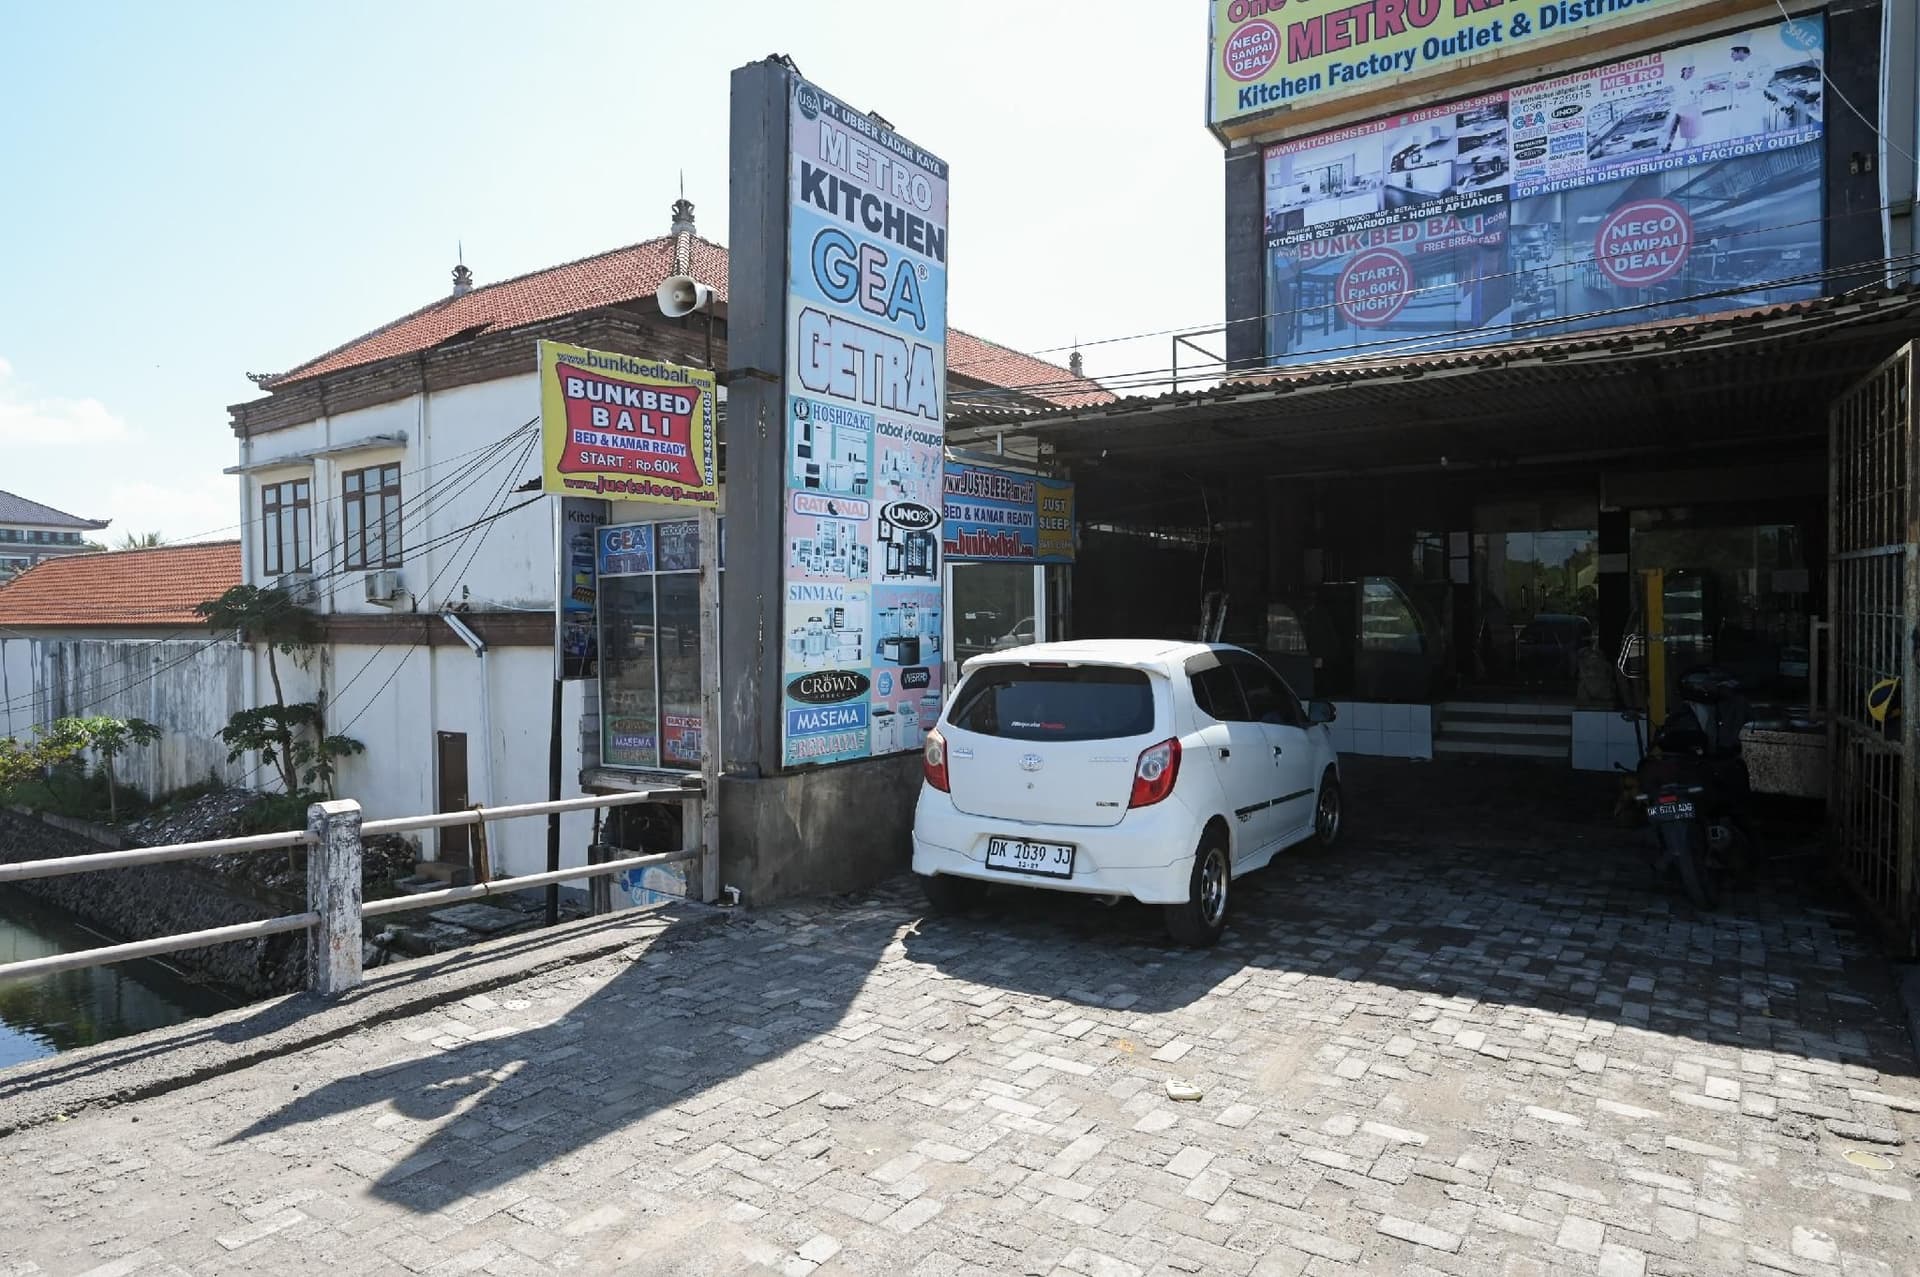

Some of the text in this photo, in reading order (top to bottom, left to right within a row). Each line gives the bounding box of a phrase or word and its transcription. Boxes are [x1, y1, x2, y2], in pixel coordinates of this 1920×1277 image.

[1233, 31, 1271, 50] NEGO
[1288, 0, 1441, 64] METRO
[1231, 43, 1273, 62] SAMPAI
[1235, 55, 1270, 73] DEAL
[1239, 73, 1321, 110] Kitchen
[1328, 48, 1416, 86] Factory
[1422, 20, 1503, 60] Outlet
[1510, 12, 1532, 38] &
[1511, 53, 1662, 97] www.metrokitchen.id
[1603, 67, 1662, 90] METRO
[799, 91, 819, 113] USA
[1513, 111, 1545, 130] GEA
[823, 97, 941, 175] PT. UBBER SADAR KAYA
[1267, 121, 1387, 158] WWW.KITCHENSET.ID
[819, 120, 933, 212] METRO
[1516, 185, 1540, 197] TOP
[1542, 176, 1595, 193] KITCHEN
[1597, 157, 1683, 181] DISTRIBUTOR
[1688, 153, 1698, 164] &
[1701, 141, 1763, 161] FACTORY
[1767, 129, 1822, 149] OUTLET
[801, 160, 945, 263] KITCHEN
[1268, 232, 1313, 248] KITCHEN
[1316, 227, 1336, 239] SET
[1346, 214, 1401, 232] WARDOBE
[1410, 205, 1442, 220] HOME
[1445, 193, 1504, 213] APLIANCE
[1612, 216, 1676, 240] NEGO
[1298, 230, 1366, 261] BUNK
[1368, 220, 1419, 250] BED
[1423, 241, 1446, 252] FREE
[1609, 232, 1678, 255] SAMPAI
[1614, 251, 1673, 272] DEAL
[812, 228, 926, 331] GEA
[1349, 266, 1400, 285] START:
[1352, 295, 1397, 313] NIGHT
[557, 352, 711, 388] www.bunkbedbali.com
[798, 306, 939, 421] GETRA
[566, 376, 692, 416] BUNKBED
[591, 405, 671, 438] BALI
[813, 404, 871, 431] HOSHIZAKI
[876, 422, 903, 438] robot
[575, 431, 686, 456] BED & KAMAR READY
[580, 452, 624, 467] START
[636, 459, 680, 474] Rp.60K
[891, 508, 929, 524] UNOX
[944, 504, 1033, 527] BED & KAMAR READY
[1043, 498, 1065, 512] JUST
[1039, 517, 1070, 531] SLEEP
[606, 529, 647, 551] GEA
[789, 585, 843, 601] SINMAG
[797, 708, 859, 730] MASEMA
[616, 737, 651, 747] MASEMA
[991, 841, 1071, 864] DK 1039 JJ
